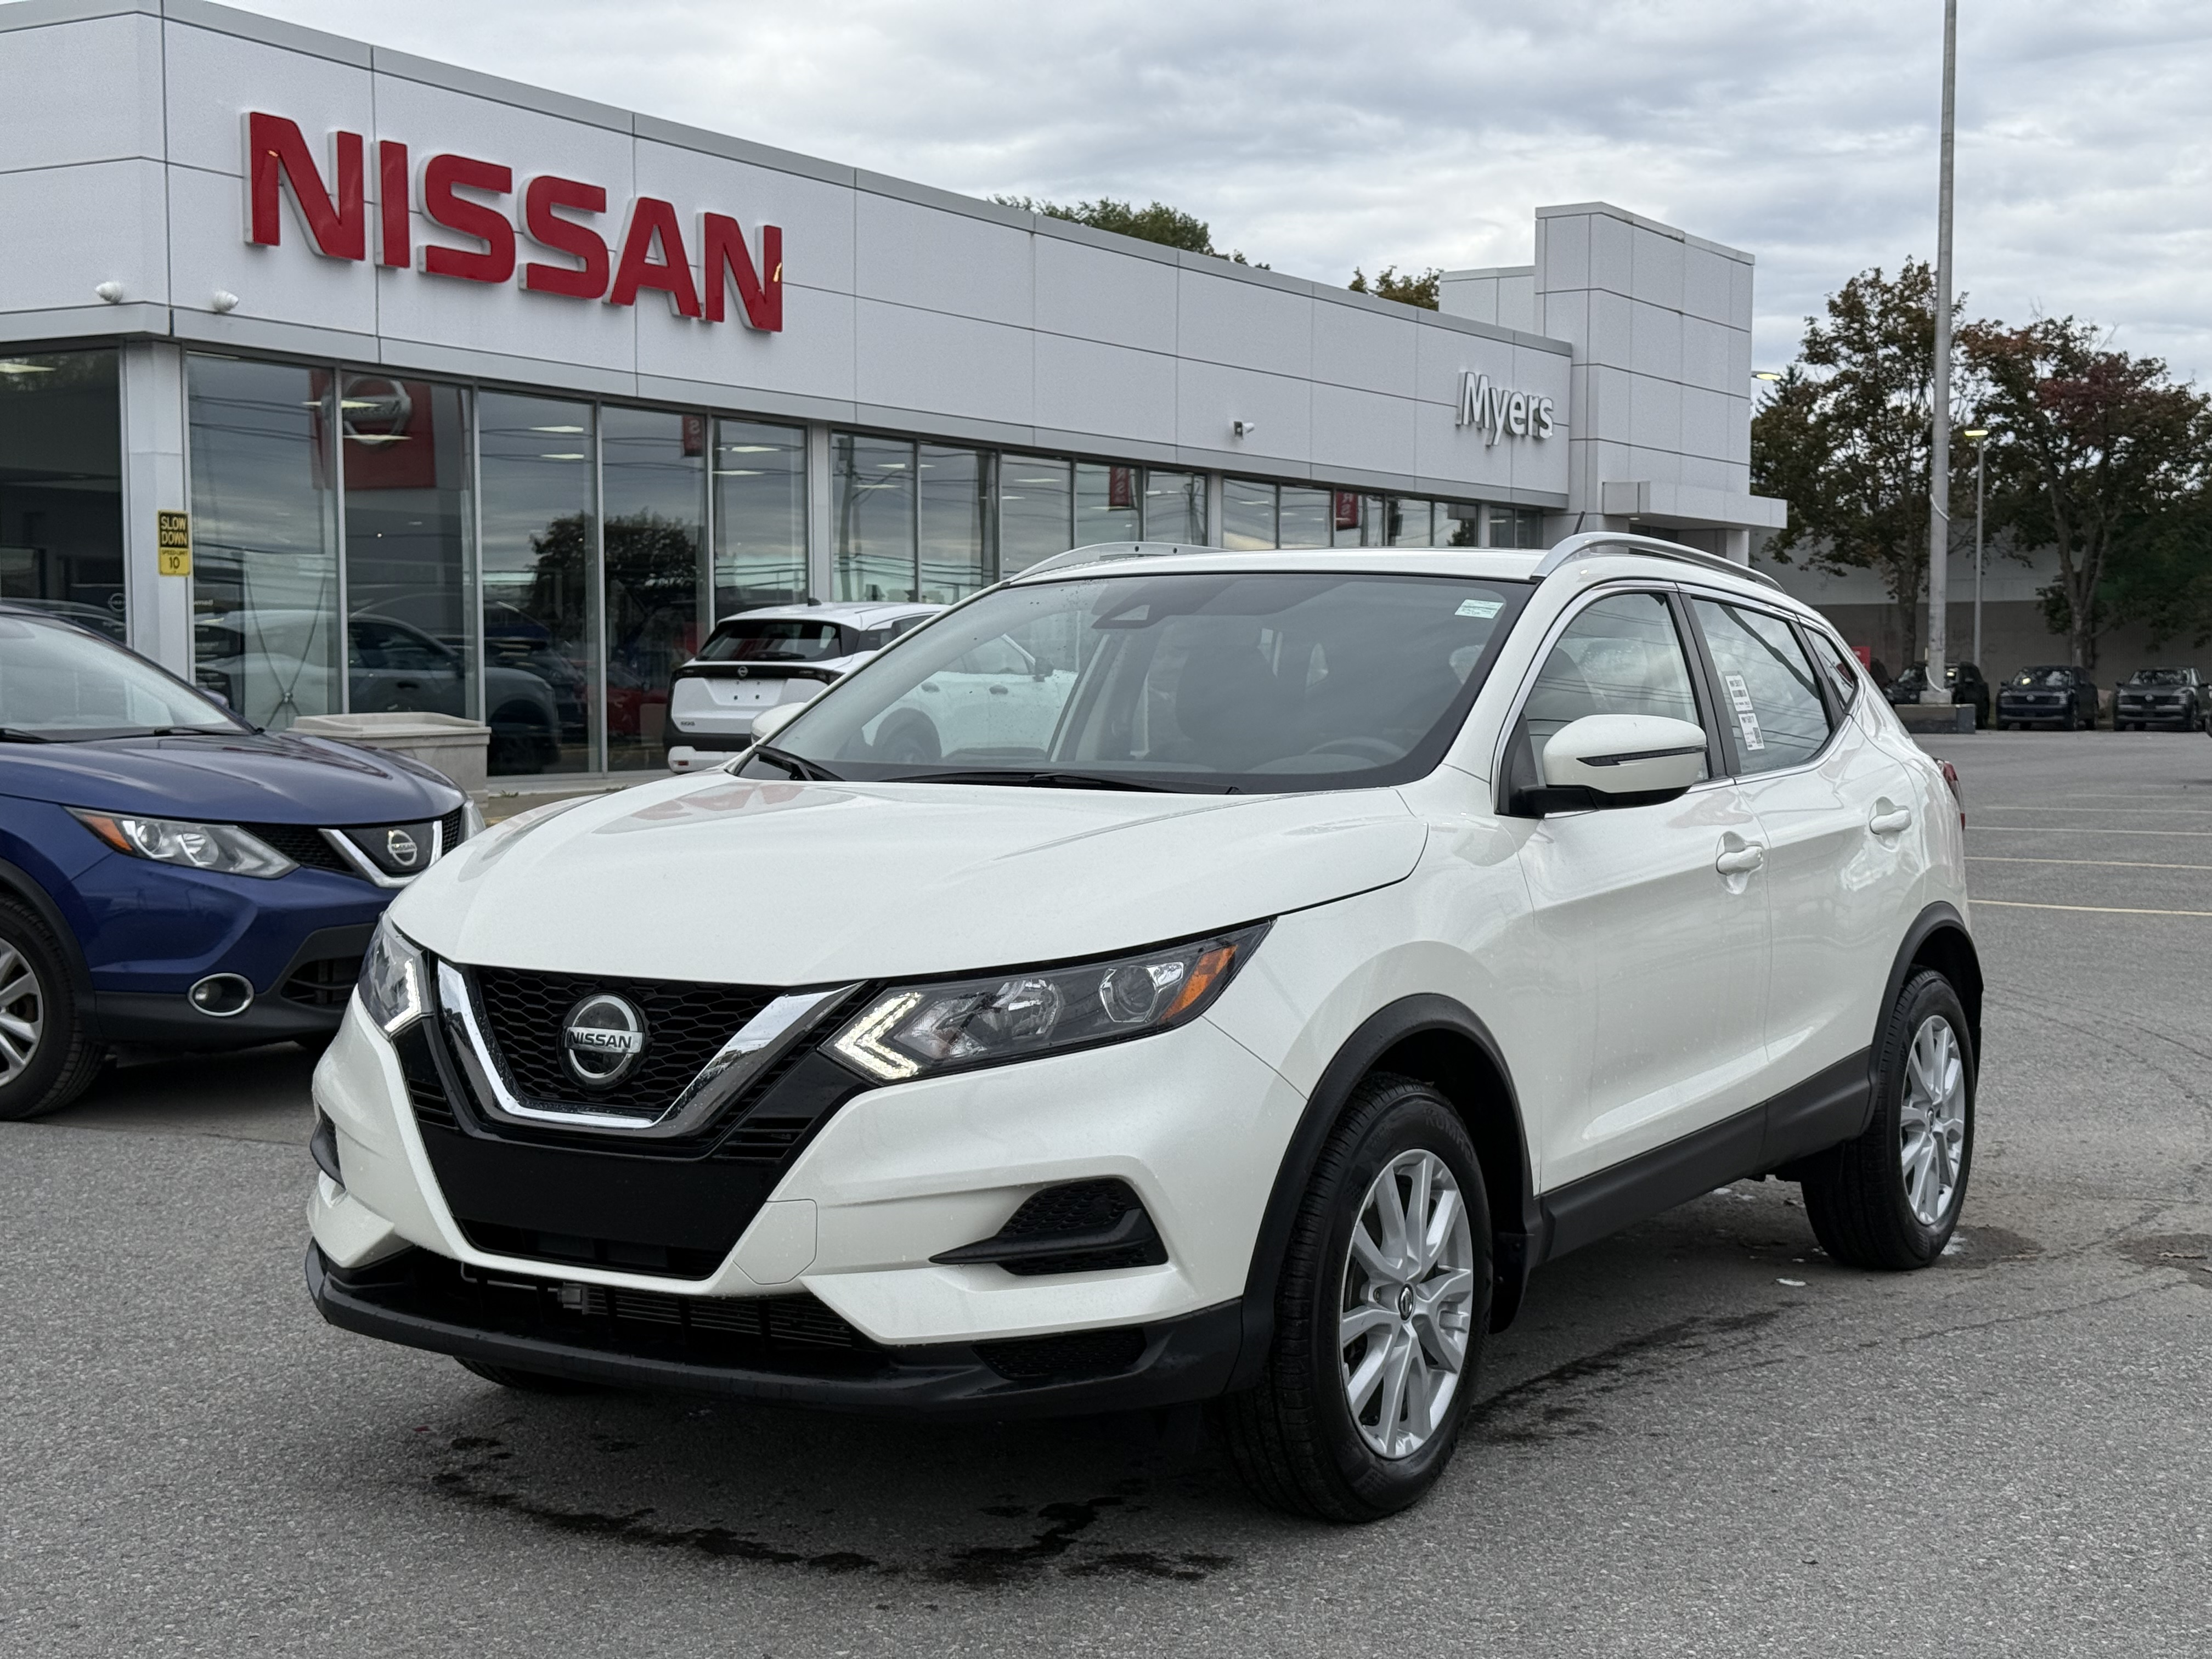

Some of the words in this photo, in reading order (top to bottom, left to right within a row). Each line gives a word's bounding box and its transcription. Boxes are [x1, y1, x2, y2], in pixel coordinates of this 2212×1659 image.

[248, 111, 783, 332] NISSAN
[1462, 371, 1553, 446] Myers
[161, 516, 187, 531] SLOW
[161, 531, 188, 545] DOWN
[169, 556, 180, 569] 10
[391, 843, 415, 851] NSSAN
[568, 1031, 631, 1048] NISSAN
